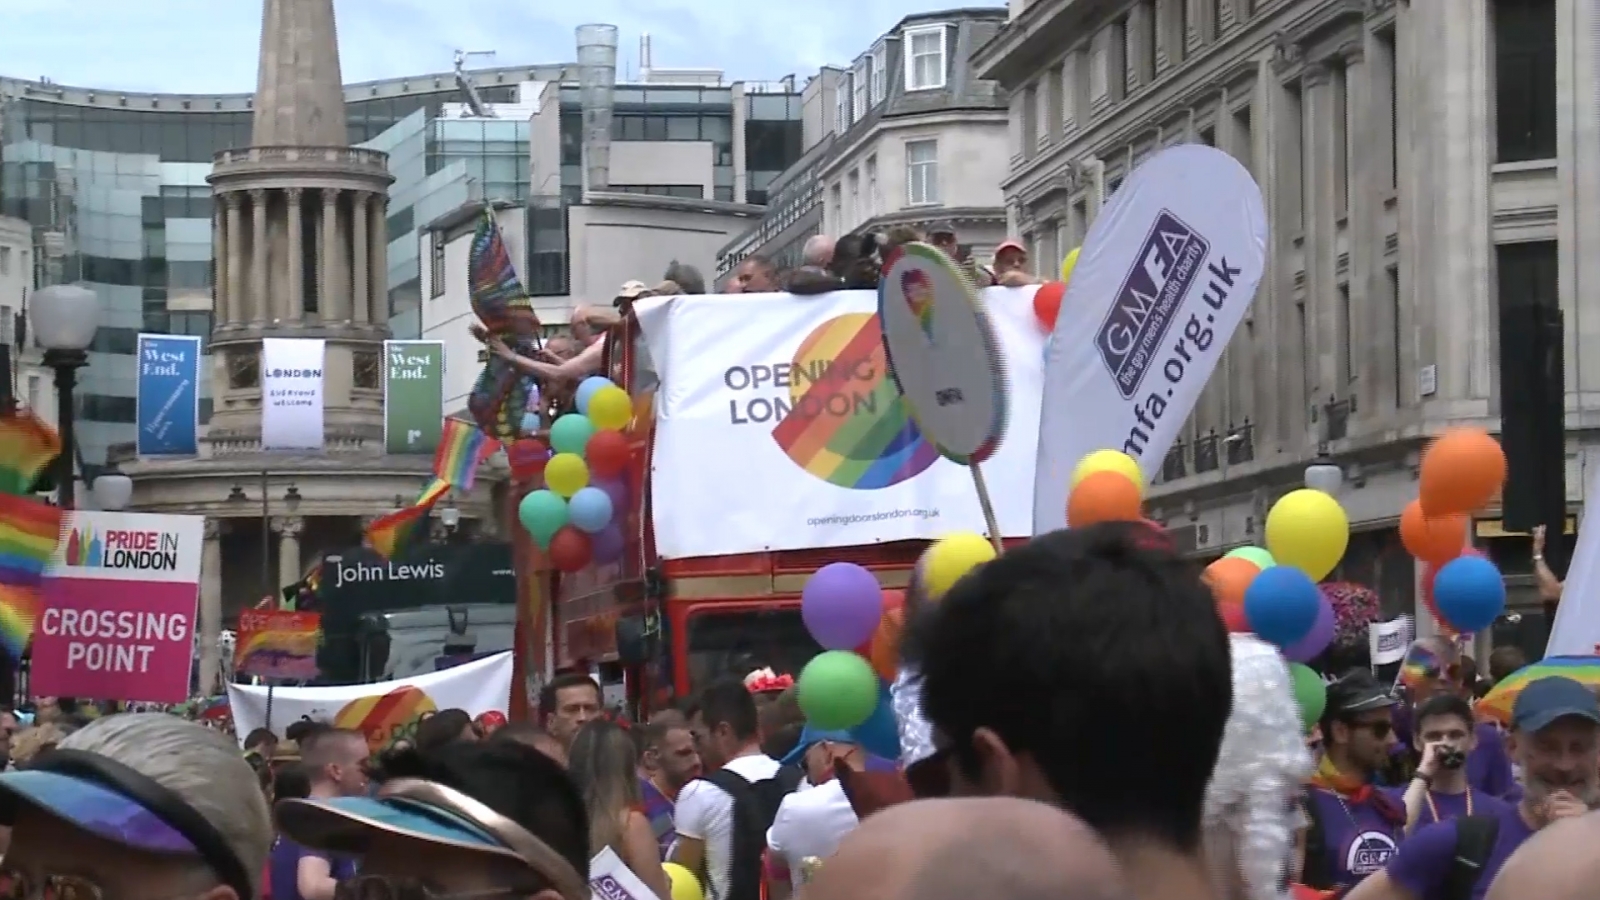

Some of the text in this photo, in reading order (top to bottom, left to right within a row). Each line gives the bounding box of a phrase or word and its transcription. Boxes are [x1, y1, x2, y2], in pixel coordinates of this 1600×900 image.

[1107, 230, 1190, 355] GMFA
[1119, 241, 1203, 386] the gay men's health charity
[144, 349, 185, 362] West
[391, 353, 431, 366] West
[1123, 256, 1242, 456] mfa.org.uk
[265, 369, 322, 378] LONDON
[391, 366, 428, 379] End.
[724, 357, 875, 391] OPENING
[730, 390, 876, 425] LONDON
[807, 508, 940, 527] openingdoorslondon.org.uk
[106, 530, 178, 551] PRIDE IN
[104, 550, 177, 570] LONDON
[335, 558, 444, 588] John Lewis
[42, 608, 187, 641] CROSSING
[67, 642, 155, 673] POINT
